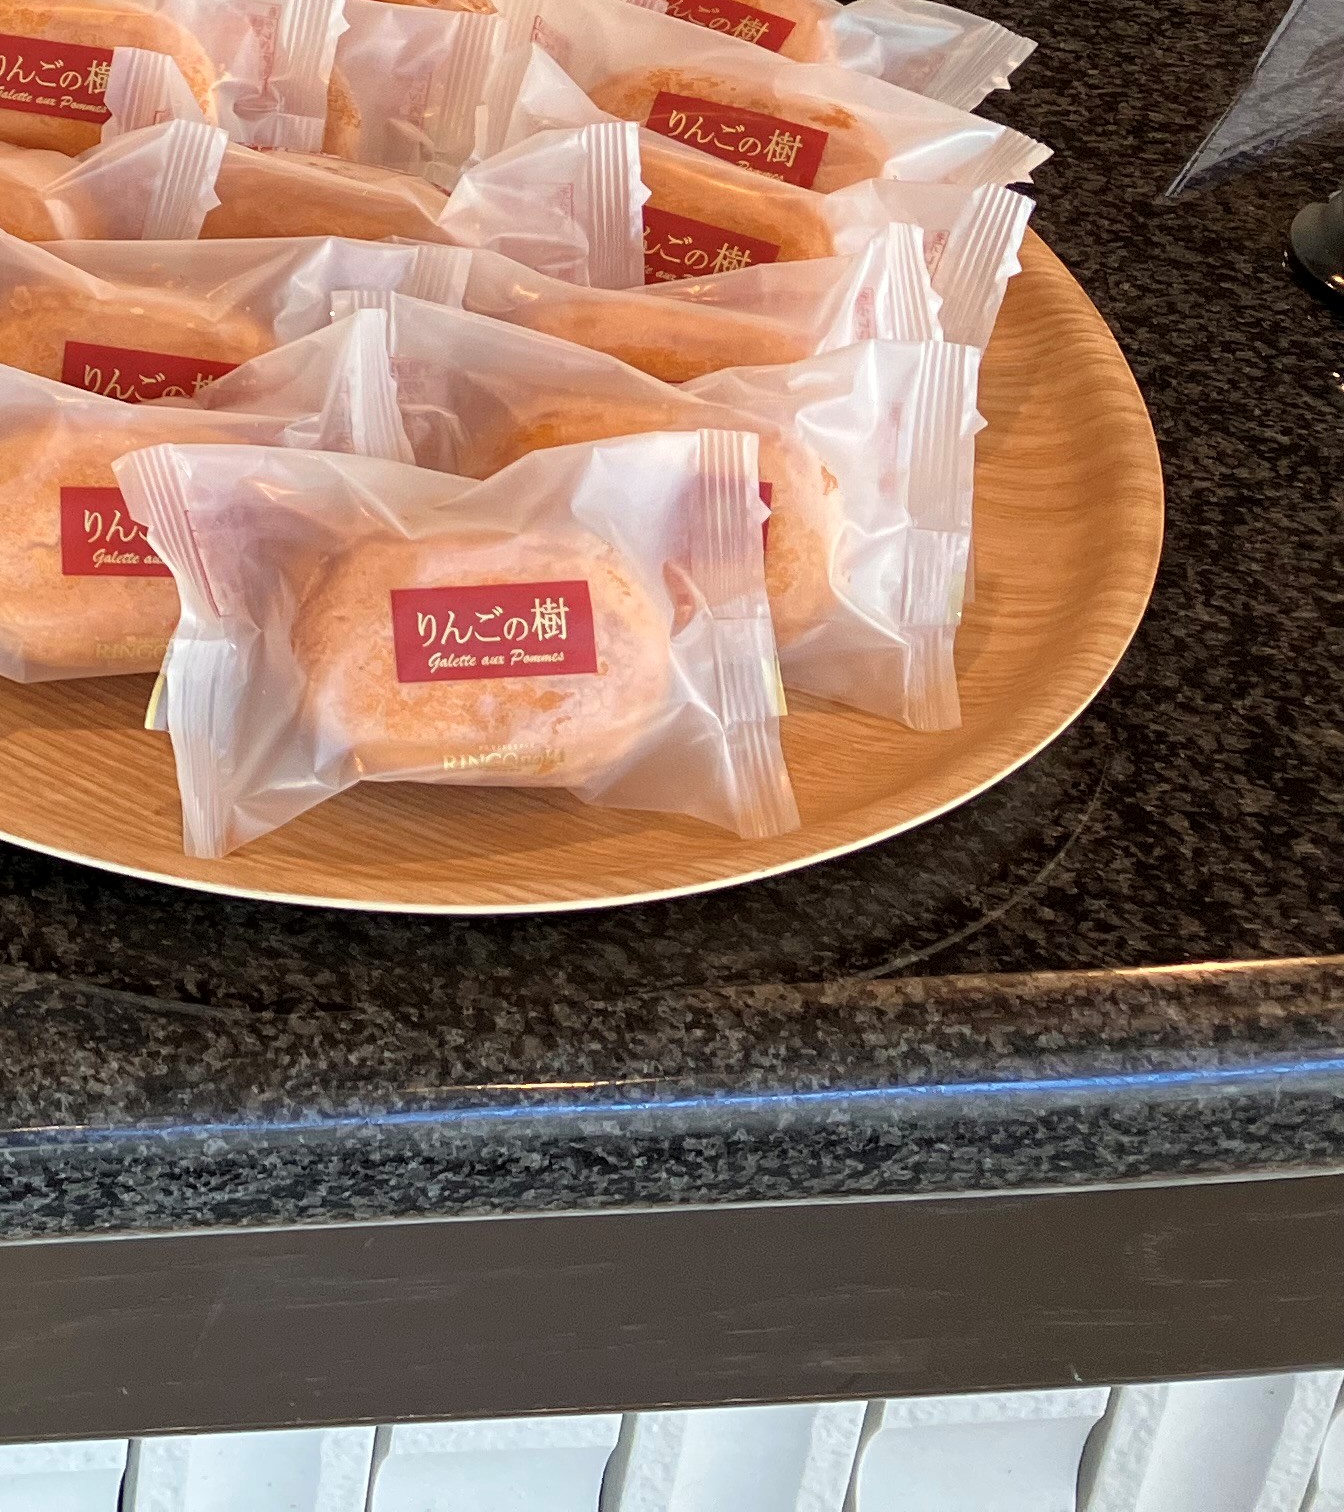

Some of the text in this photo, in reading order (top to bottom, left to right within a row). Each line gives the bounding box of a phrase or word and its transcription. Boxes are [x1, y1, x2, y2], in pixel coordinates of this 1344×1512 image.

[35, 95, 57, 106] aux
[59, 94, 109, 114] Pommes
[667, 109, 803, 168] りんごの樹
[92, 548, 140, 568] Galette
[416, 597, 570, 648] りんごの樹
[428, 648, 565, 674] Galette aux Pommes
